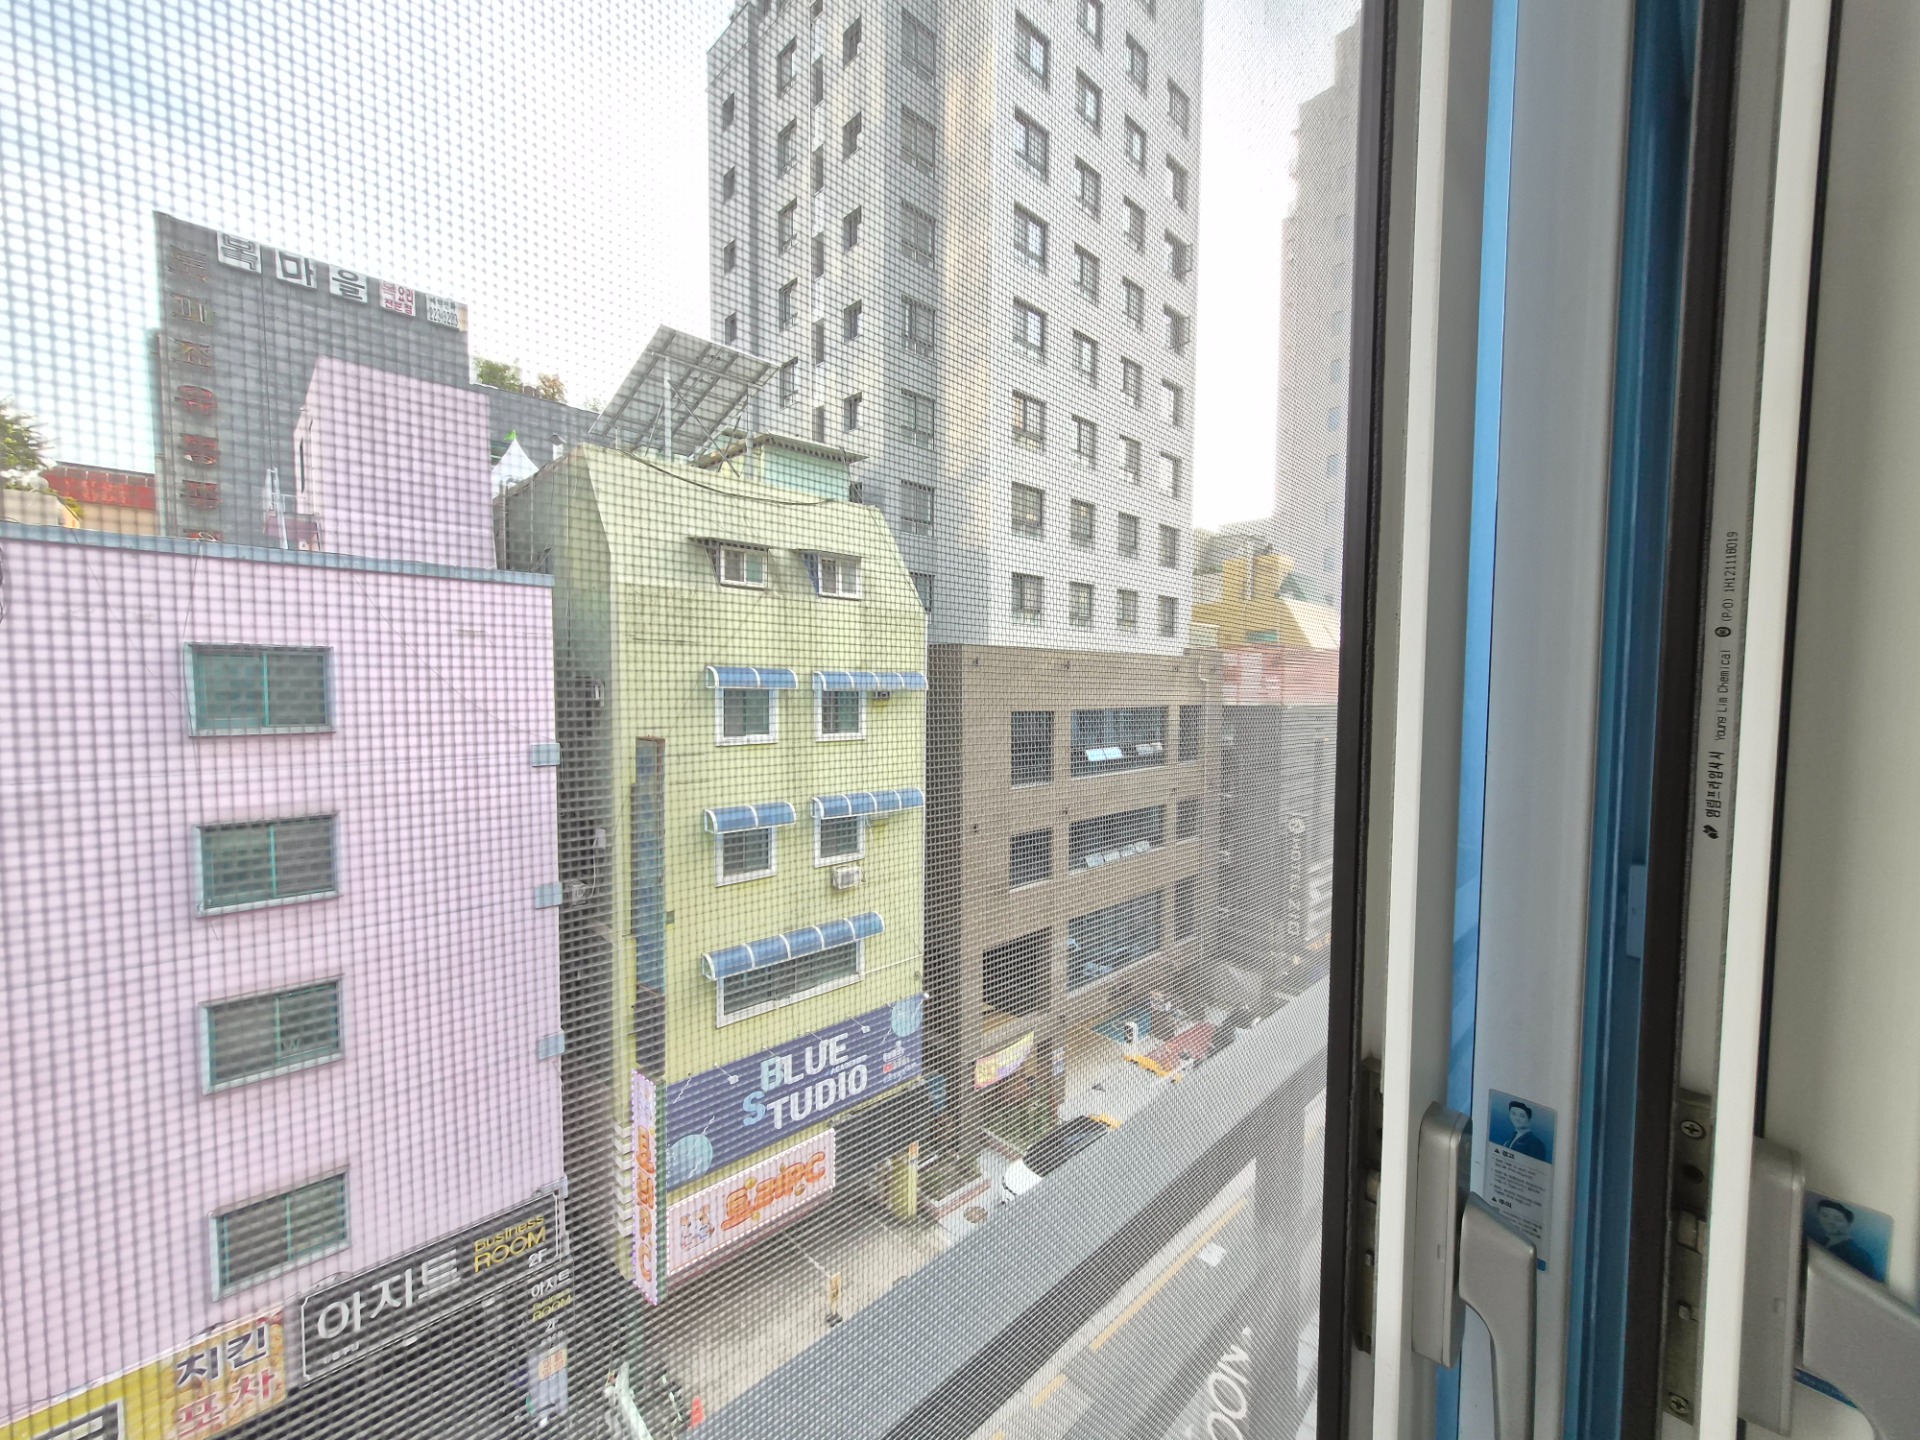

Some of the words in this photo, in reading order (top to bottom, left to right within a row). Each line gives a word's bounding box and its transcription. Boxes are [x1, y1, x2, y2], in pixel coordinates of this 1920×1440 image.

[1717, 650, 1731, 694] Chemical
[1714, 716, 1727, 741] Young
[1716, 697, 1729, 713] Lim
[759, 1032, 849, 1093] BLUE
[742, 1064, 868, 1130] STUDIO
[474, 1226, 546, 1274] ROOM
[528, 1247, 548, 1268] 2F
[318, 1247, 461, 1339] 아지트
[175, 1324, 268, 1387] 치킨
[175, 1367, 276, 1439] 포차
